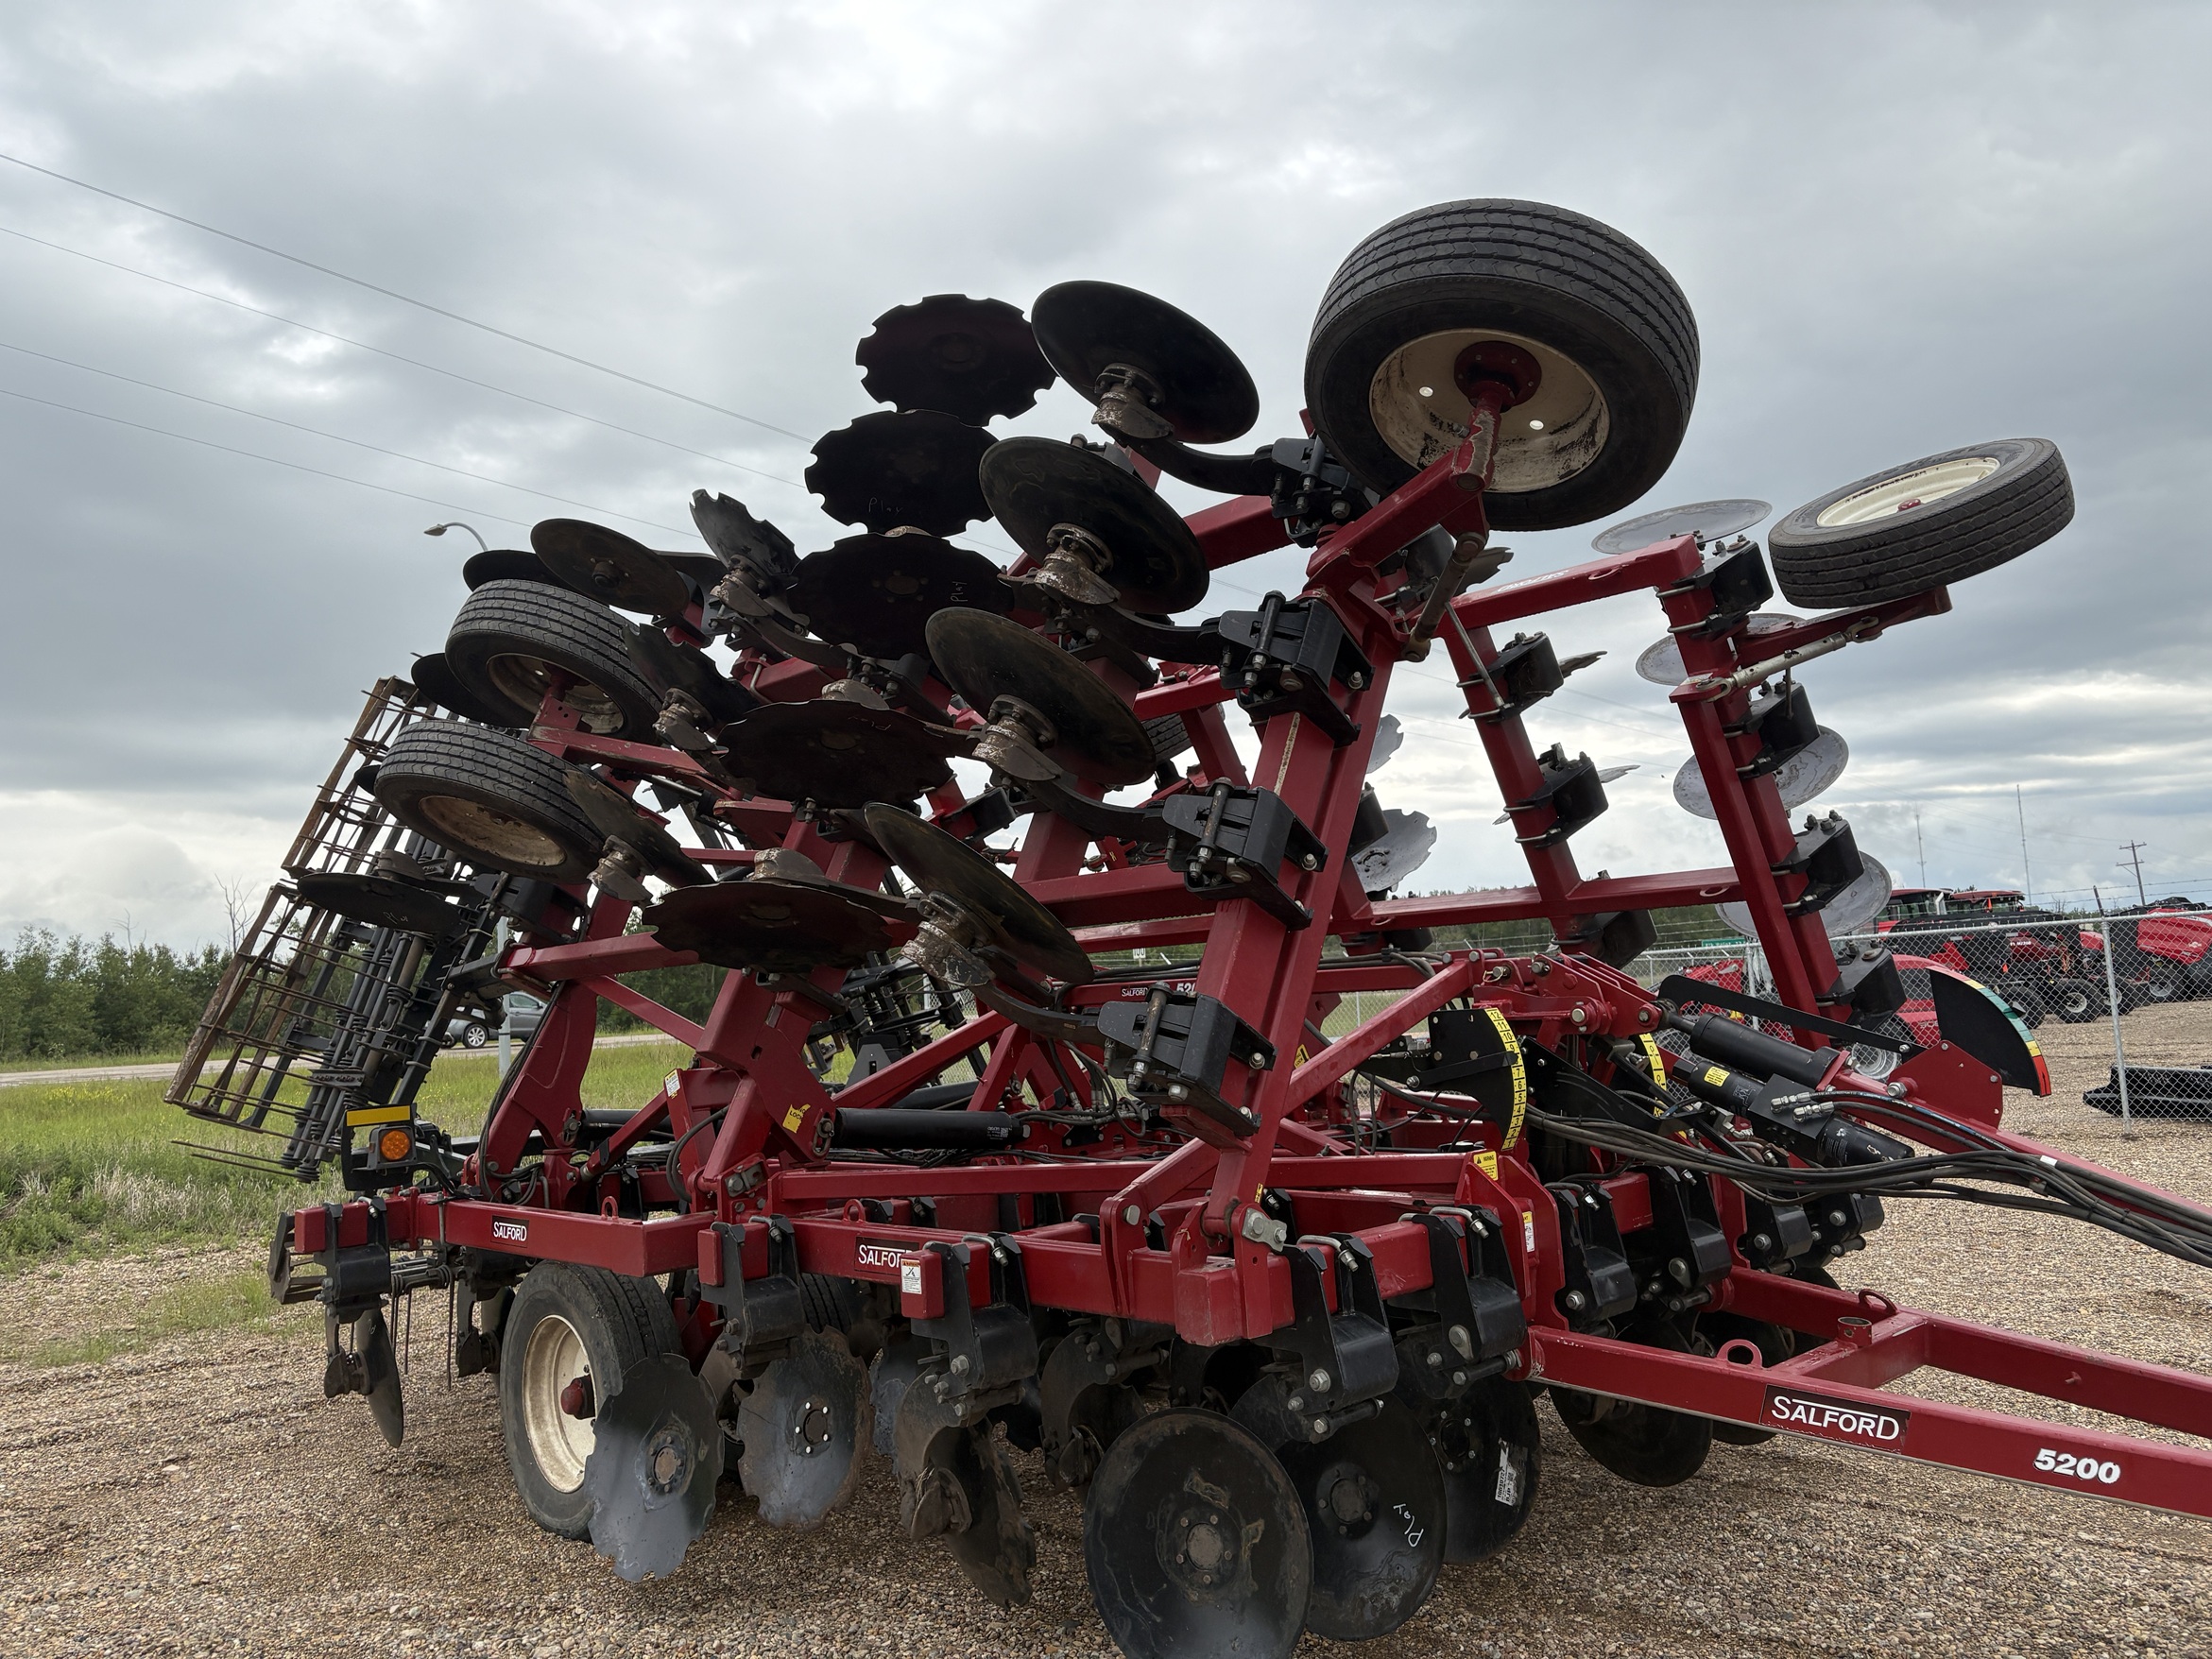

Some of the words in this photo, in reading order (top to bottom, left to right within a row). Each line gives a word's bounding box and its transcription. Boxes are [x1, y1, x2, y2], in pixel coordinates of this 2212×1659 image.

[1498, 1021, 1507, 1030] 11
[1503, 1032, 1513, 1041] 10
[493, 1221, 527, 1241] SALFORD
[858, 1244, 911, 1268] SALFO
[1771, 1395, 1900, 1441] SALFORD
[2032, 1447, 2121, 1484] 5200
[1393, 1503, 1425, 1548] Play
